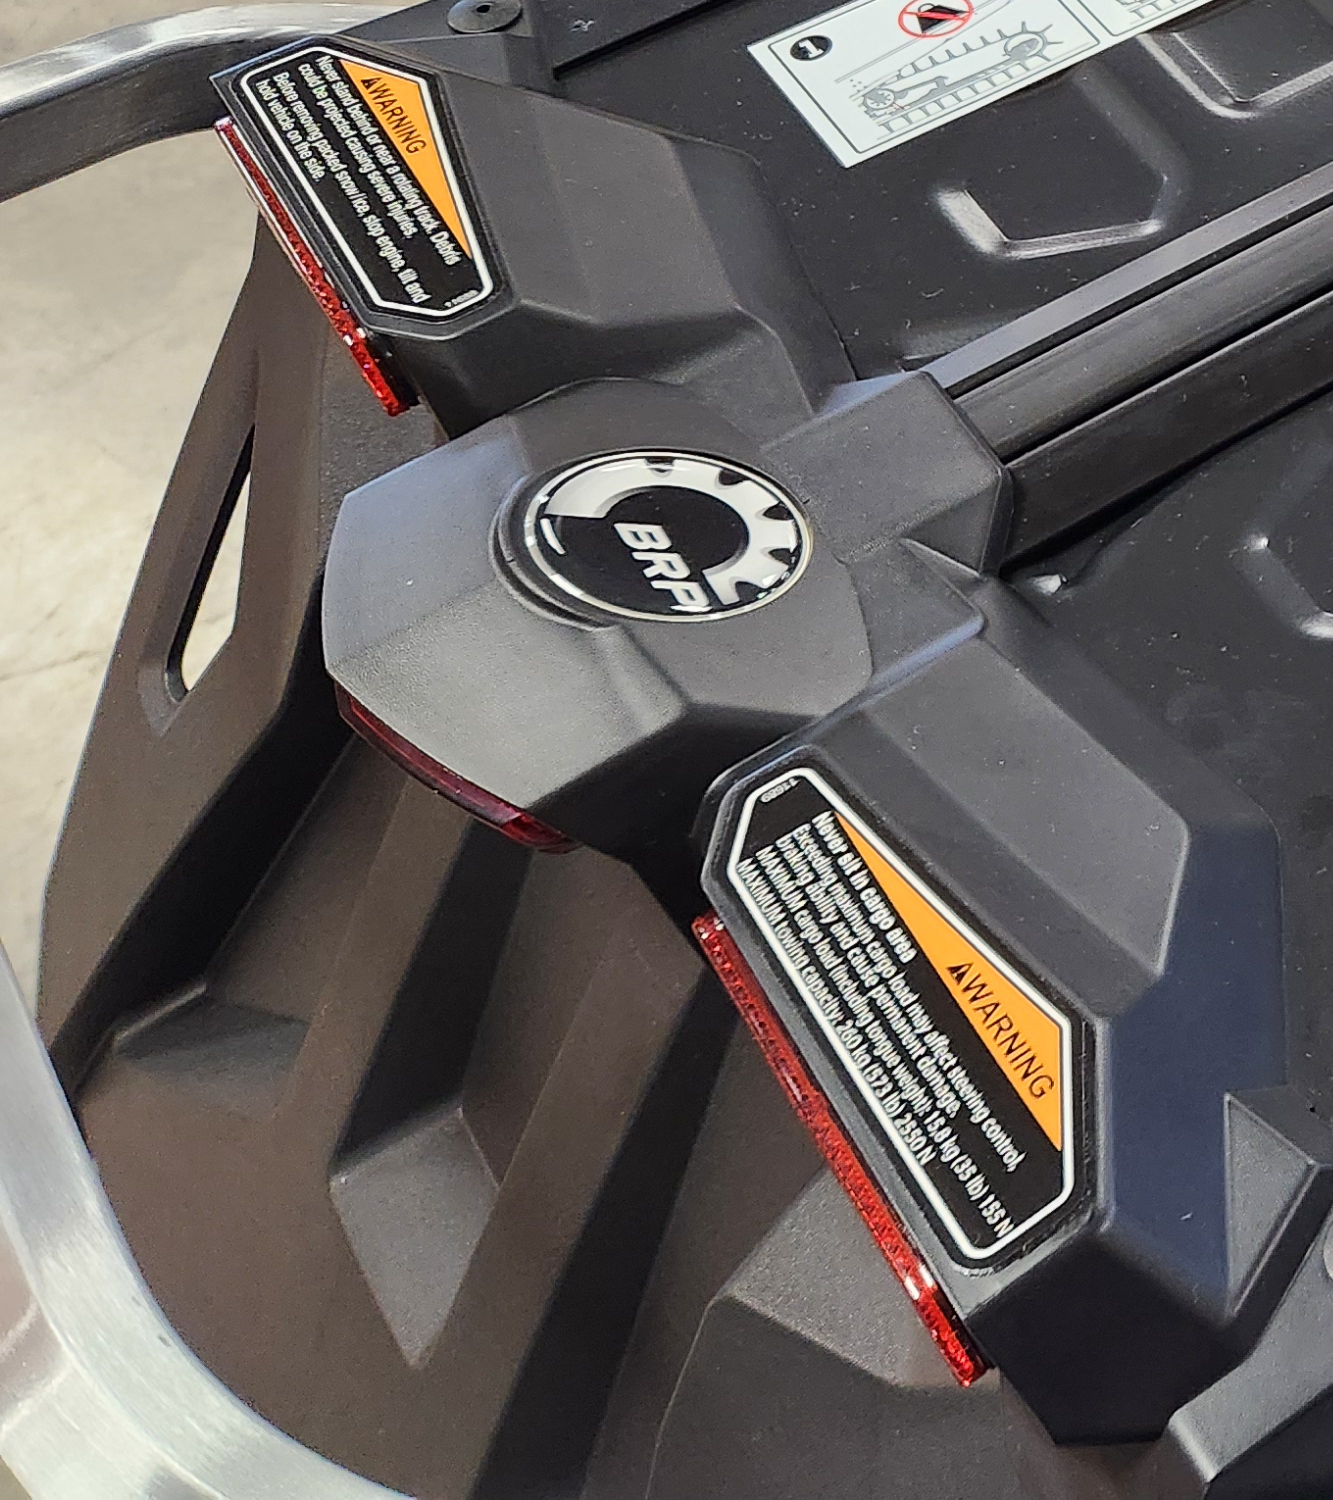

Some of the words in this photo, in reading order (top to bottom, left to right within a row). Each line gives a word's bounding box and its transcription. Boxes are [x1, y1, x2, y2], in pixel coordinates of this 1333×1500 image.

[298, 63, 325, 88] could
[315, 55, 341, 82] Never
[255, 78, 280, 101] hold
[273, 71, 299, 102] Before
[312, 84, 328, 100] be
[331, 81, 359, 107] stand
[268, 99, 295, 131] vehicle
[290, 100, 324, 142] removing
[317, 98, 357, 138] projected
[346, 103, 378, 136] behind
[368, 83, 427, 154] WARNING
[286, 130, 303, 145] on
[294, 141, 313, 160] the
[365, 134, 383, 146] or
[304, 157, 326, 182] side.
[311, 139, 347, 172] packed
[345, 137, 376, 173] causing
[372, 144, 397, 166] near
[385, 165, 401, 175] a
[367, 170, 396, 203] severe
[391, 173, 423, 210] rotating
[362, 214, 385, 237] stop
[376, 235, 405, 272] engine,
[430, 231, 461, 265] Debris
[397, 268, 418, 285] tilt
[405, 282, 431, 304] and
[613, 522, 710, 607] BRP
[812, 811, 848, 854] Never
[837, 852, 863, 876] sit
[849, 869, 870, 891] in
[733, 858, 786, 926] MAXIMUM
[860, 887, 895, 930] cargo
[770, 920, 810, 972] towing
[776, 832, 815, 886] braking
[805, 880, 840, 924] ability
[830, 921, 860, 950] and
[847, 947, 880, 988] cause
[865, 984, 925, 1060] permanent
[885, 927, 917, 963] area
[790, 823, 838, 888] Exceeding
[828, 882, 875, 944] maximum
[866, 941, 897, 979] cargo
[888, 972, 920, 1007] load
[905, 1002, 933, 1034] may
[923, 1031, 958, 1071] affect
[947, 1066, 990, 1123] steering
[981, 1118, 1025, 1172] control,
[798, 966, 844, 1027] capacity:
[756, 845, 807, 912] MAXIMUM
[794, 909, 823, 944] cargo
[813, 937, 844, 970] load
[865, 1020, 901, 1068] tongue
[939, 1134, 961, 1163] kg
[950, 1154, 977, 1181] (35
[965, 1173, 990, 1201] lb)
[978, 1194, 1006, 1225] 155
[993, 1217, 1019, 1238] N
[834, 1019, 863, 1050] 260
[961, 972, 1055, 1100] WARNING
[848, 1043, 872, 1070] kg
[862, 1062, 893, 1098] (573
[879, 1091, 906, 1119] lb)
[894, 1112, 927, 1152] 2550
[916, 1145, 937, 1166] N
